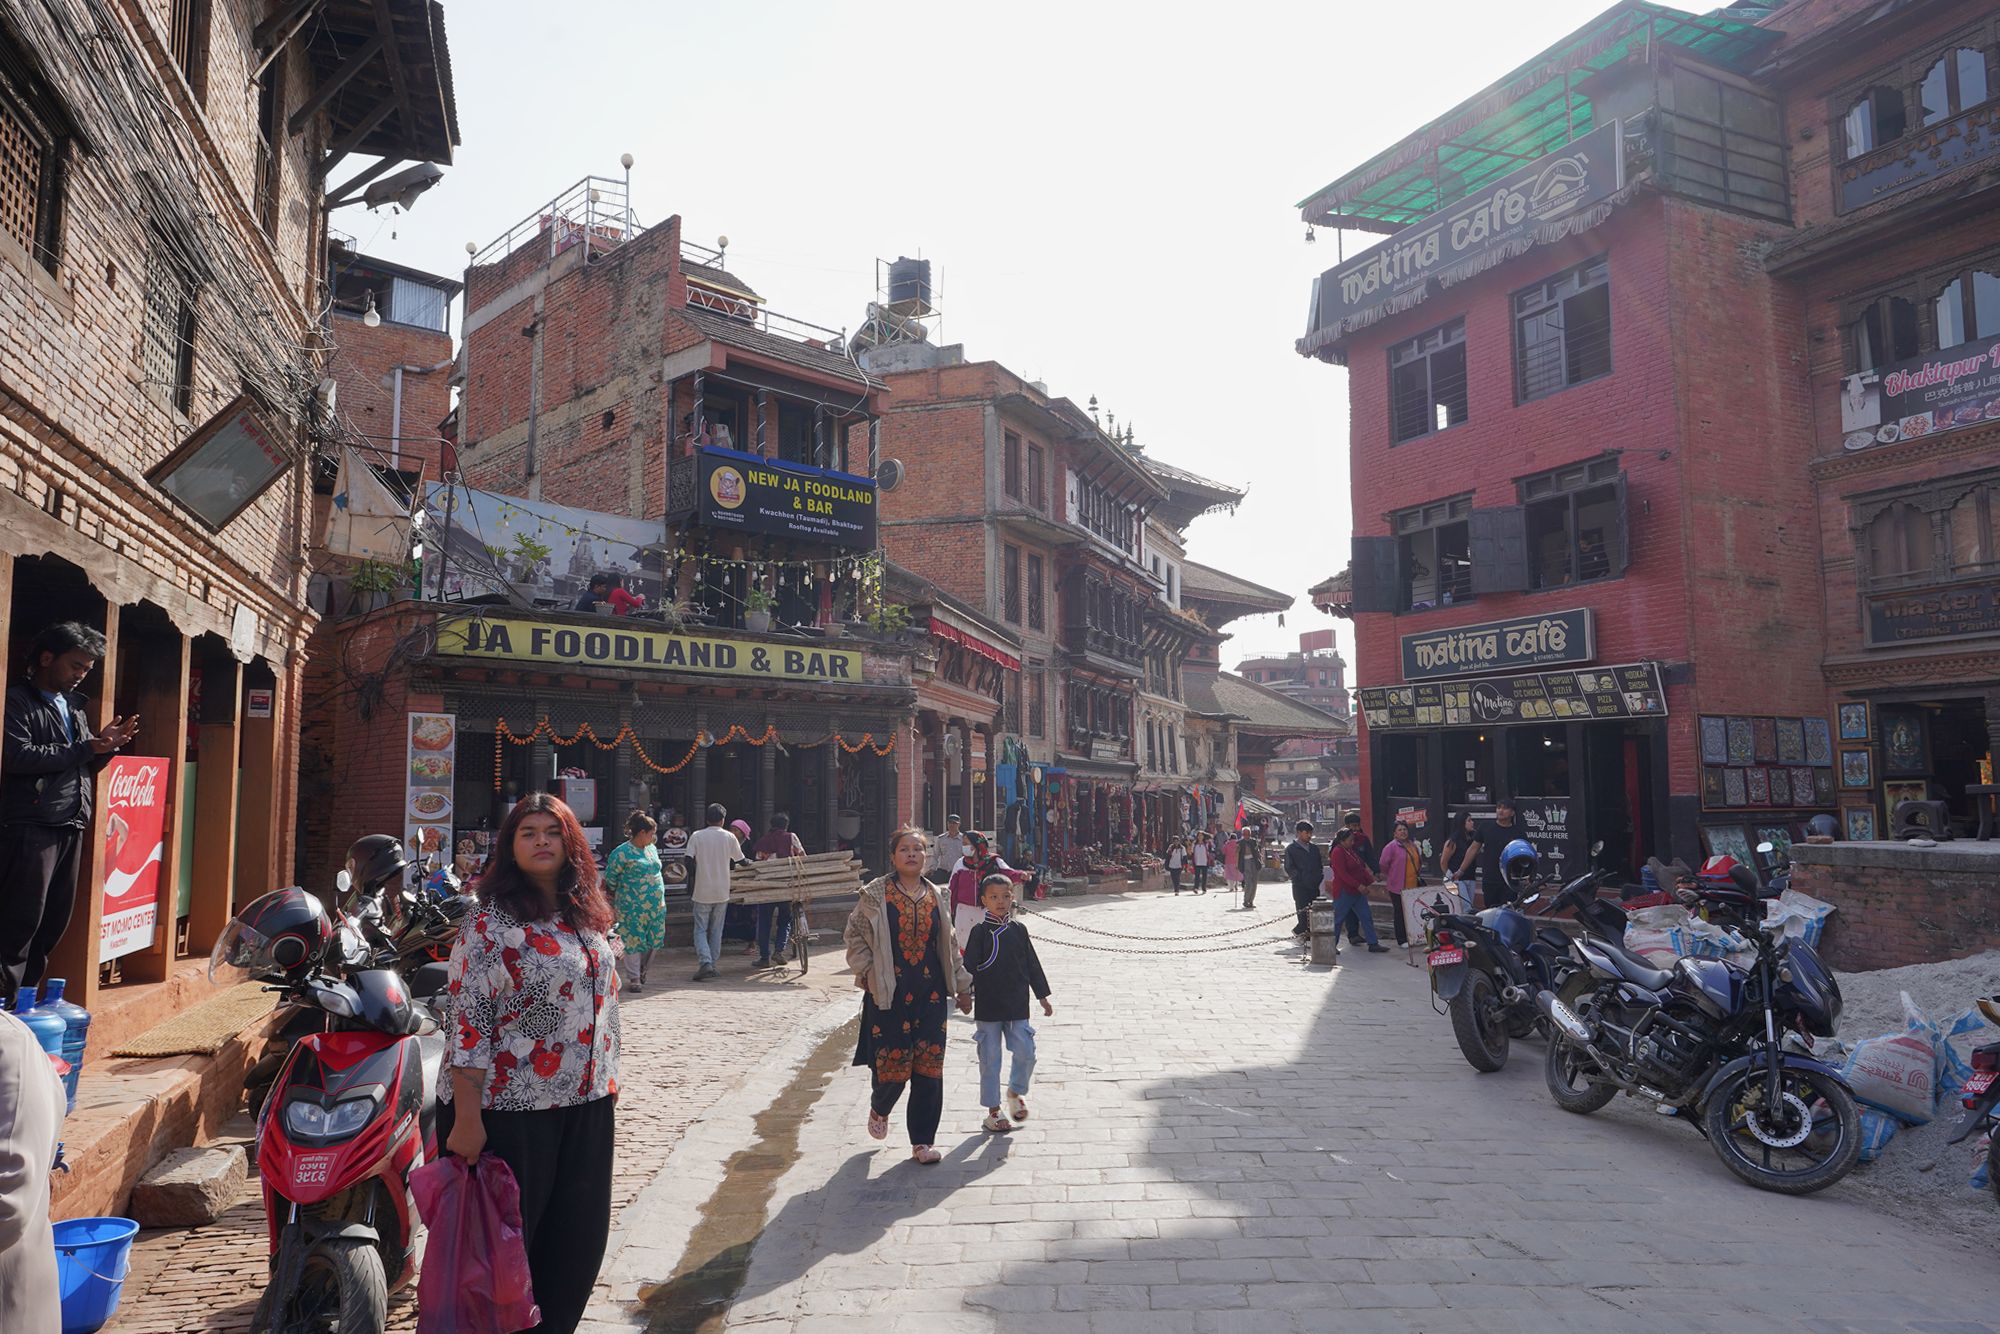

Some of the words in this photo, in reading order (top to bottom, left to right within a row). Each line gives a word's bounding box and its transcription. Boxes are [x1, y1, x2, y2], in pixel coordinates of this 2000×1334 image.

[1884, 353, 1987, 397] Bhaktapur
[748, 470, 779, 488] NEW
[783, 477, 800, 492] JA
[804, 481, 873, 505] FOODLAND
[793, 495, 802, 510] &
[807, 499, 833, 515] BAR
[788, 522, 812, 533] Rooftop
[812, 526, 839, 536] Available
[831, 519, 864, 531] Bhaktapur
[1884, 591, 1981, 618] Master
[463, 622, 513, 653] JA
[531, 628, 737, 669] FOODLAND
[750, 646, 771, 672] &
[784, 649, 850, 678] BAR
[1596, 705, 1618, 714] BURGER
[108, 764, 160, 808] Coca-Cola
[1526, 831, 1553, 839] VAILABLE
[132, 909, 155, 932] CENTER
[393, 1112, 413, 1140] 150
